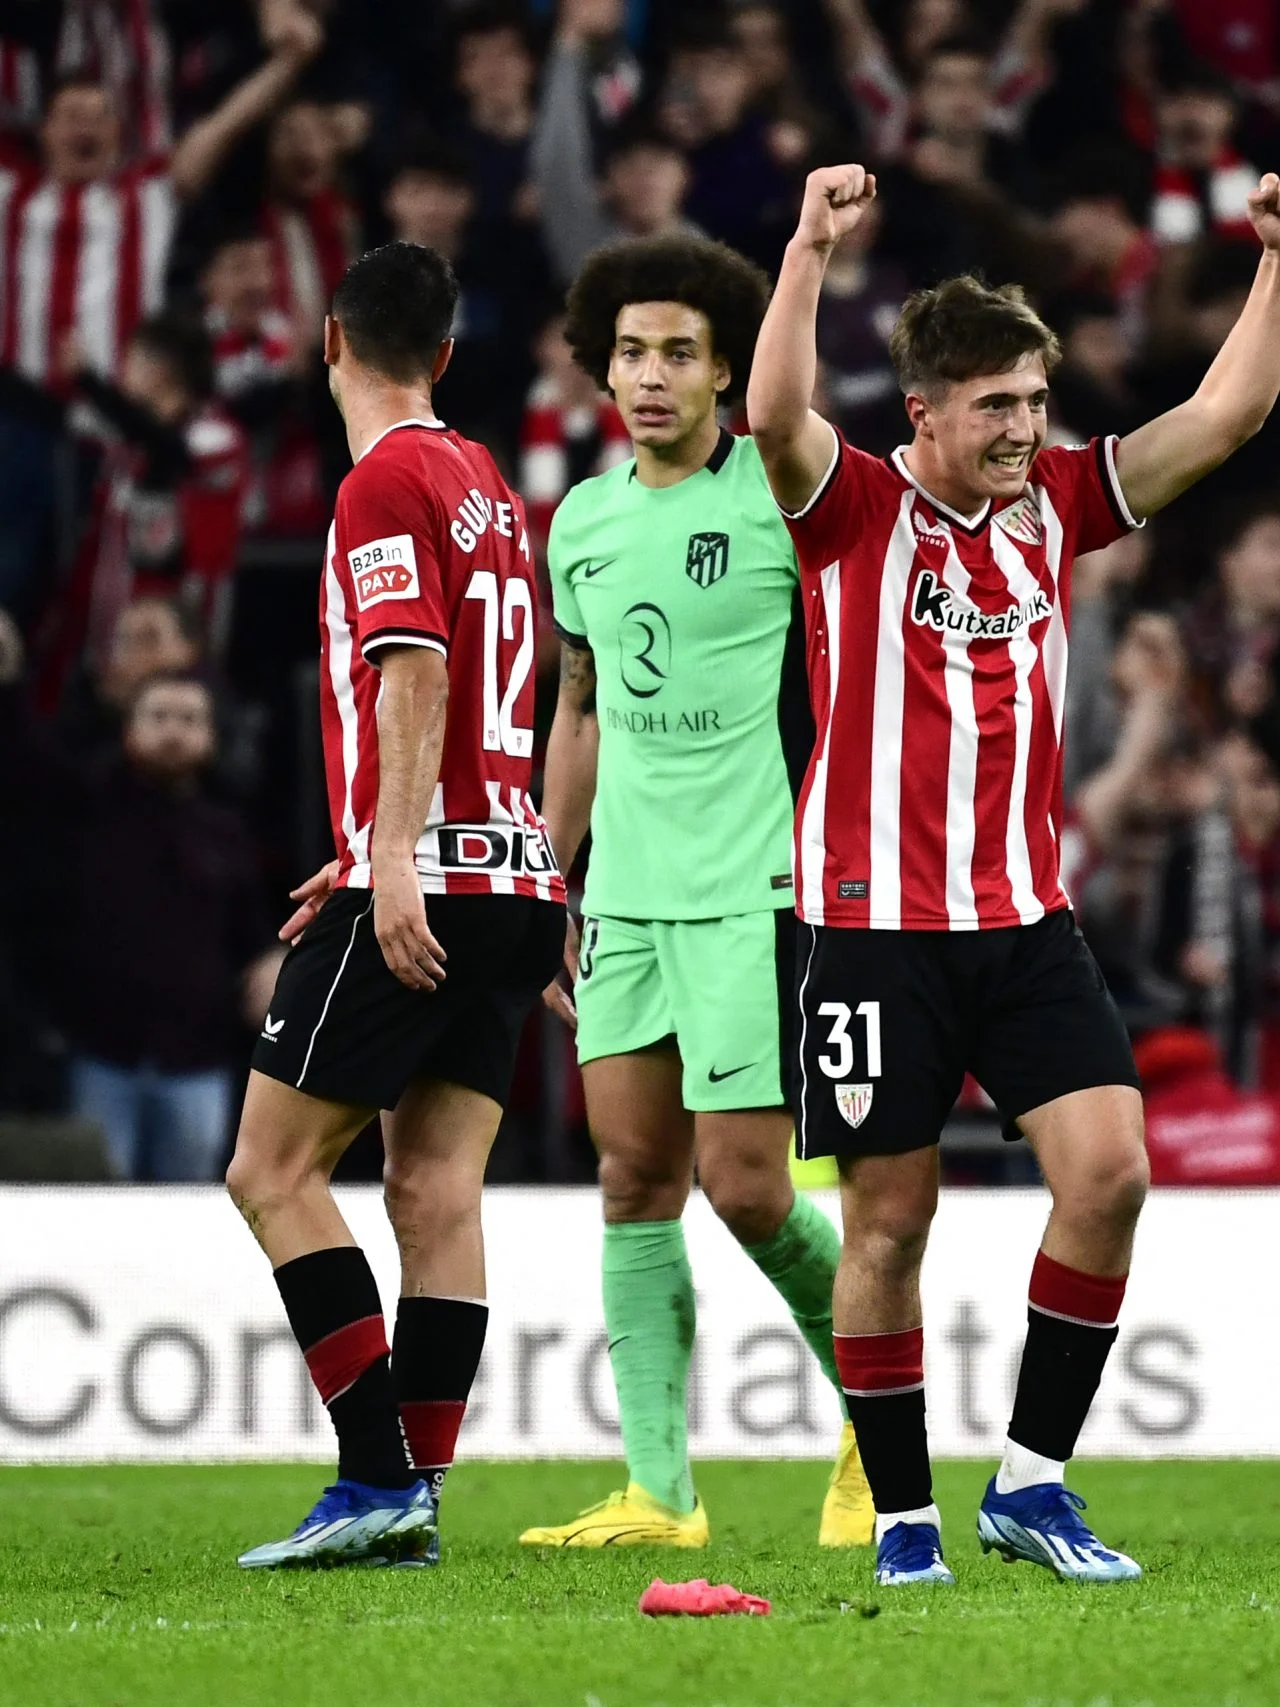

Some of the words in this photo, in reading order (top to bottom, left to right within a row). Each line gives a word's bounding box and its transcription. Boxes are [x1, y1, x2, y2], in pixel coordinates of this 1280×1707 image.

[351, 545, 402, 574] B2Bin
[361, 570, 396, 597] PAY
[914, 572, 1049, 636] Kutxabnk
[464, 569, 535, 758] 12
[676, 708, 722, 733] AIR
[816, 1000, 882, 1079] 31
